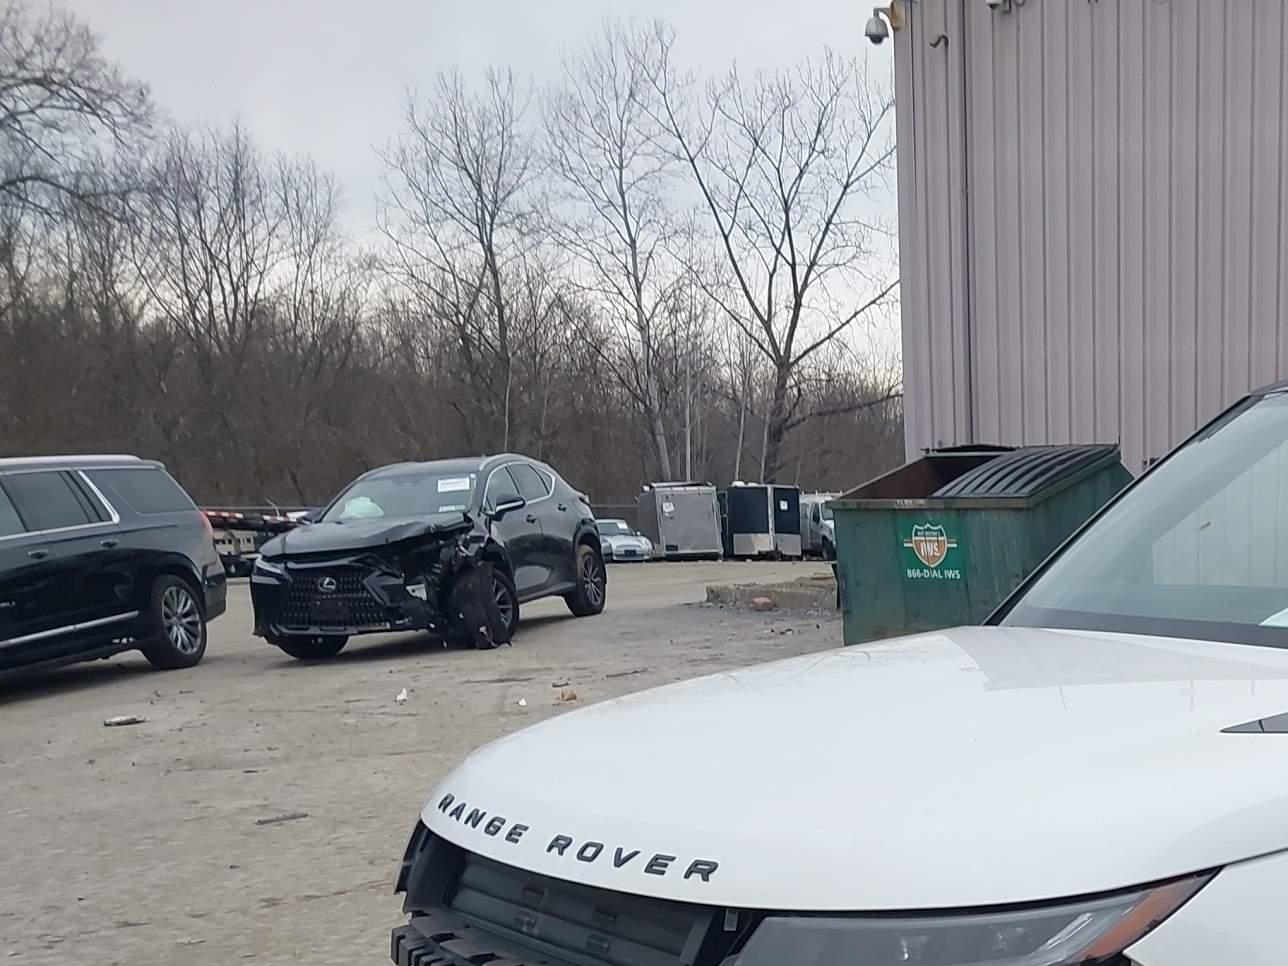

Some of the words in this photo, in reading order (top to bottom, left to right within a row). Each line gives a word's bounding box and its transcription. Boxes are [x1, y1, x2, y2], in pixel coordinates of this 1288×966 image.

[920, 542, 940, 558] IWS
[944, 569, 961, 579] IWS
[437, 793, 529, 844] RANGE
[546, 834, 720, 883] ROVER
